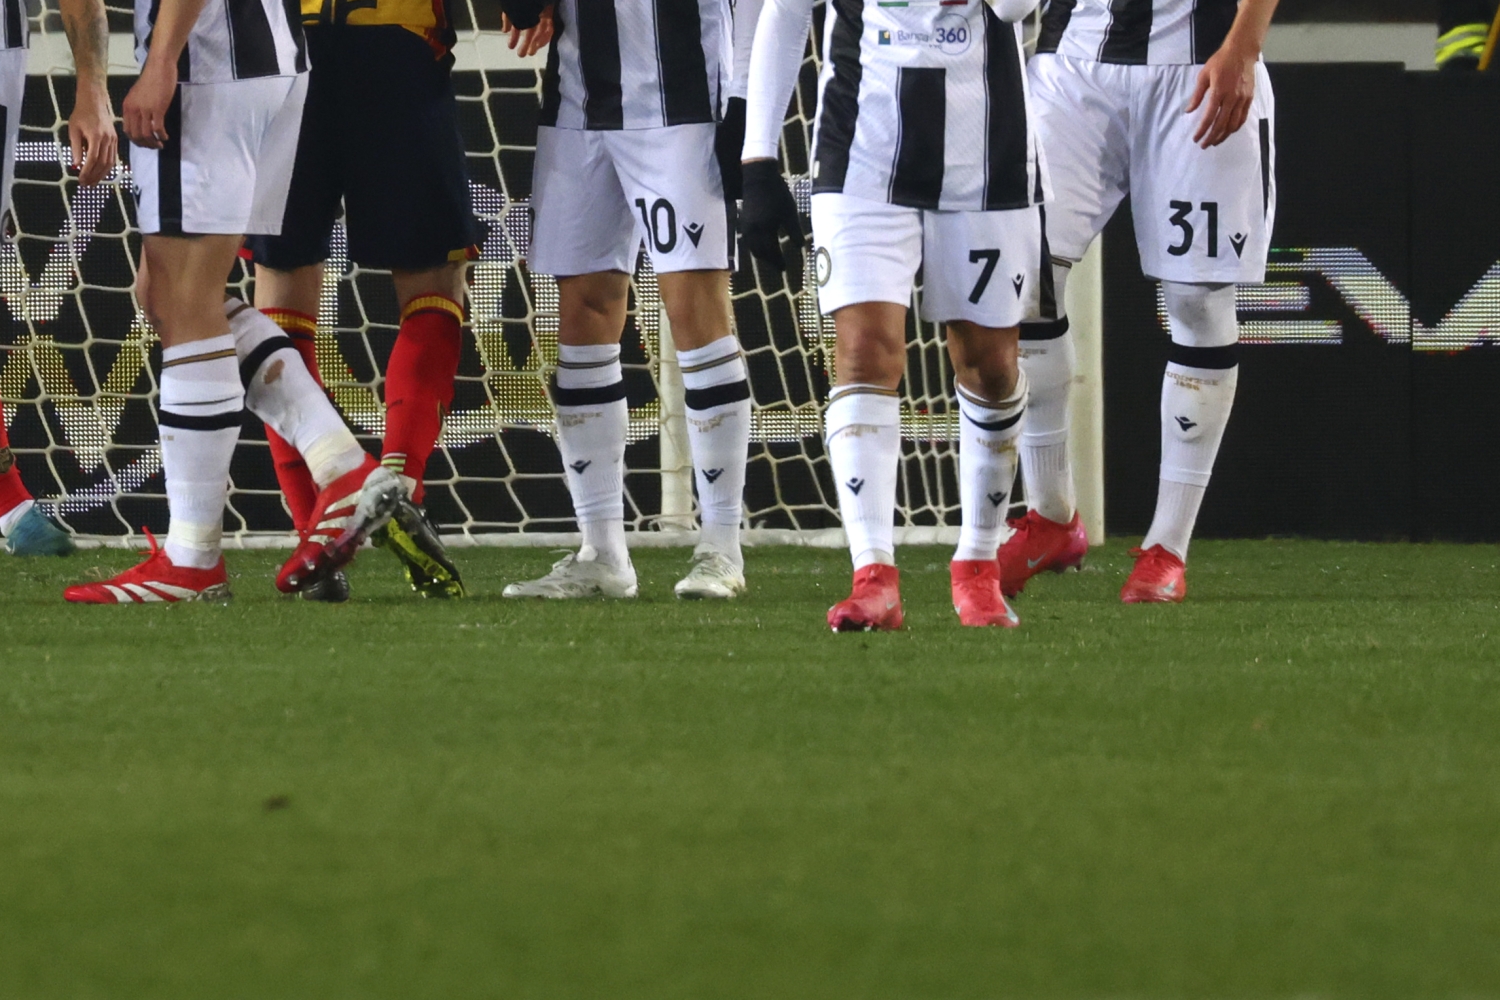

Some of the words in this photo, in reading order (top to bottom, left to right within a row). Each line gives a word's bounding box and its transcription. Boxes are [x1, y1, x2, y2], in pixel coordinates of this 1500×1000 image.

[936, 27, 967, 43] 360
[635, 197, 677, 254] 10
[1167, 200, 1218, 257] 31
[968, 248, 1001, 304] 7
